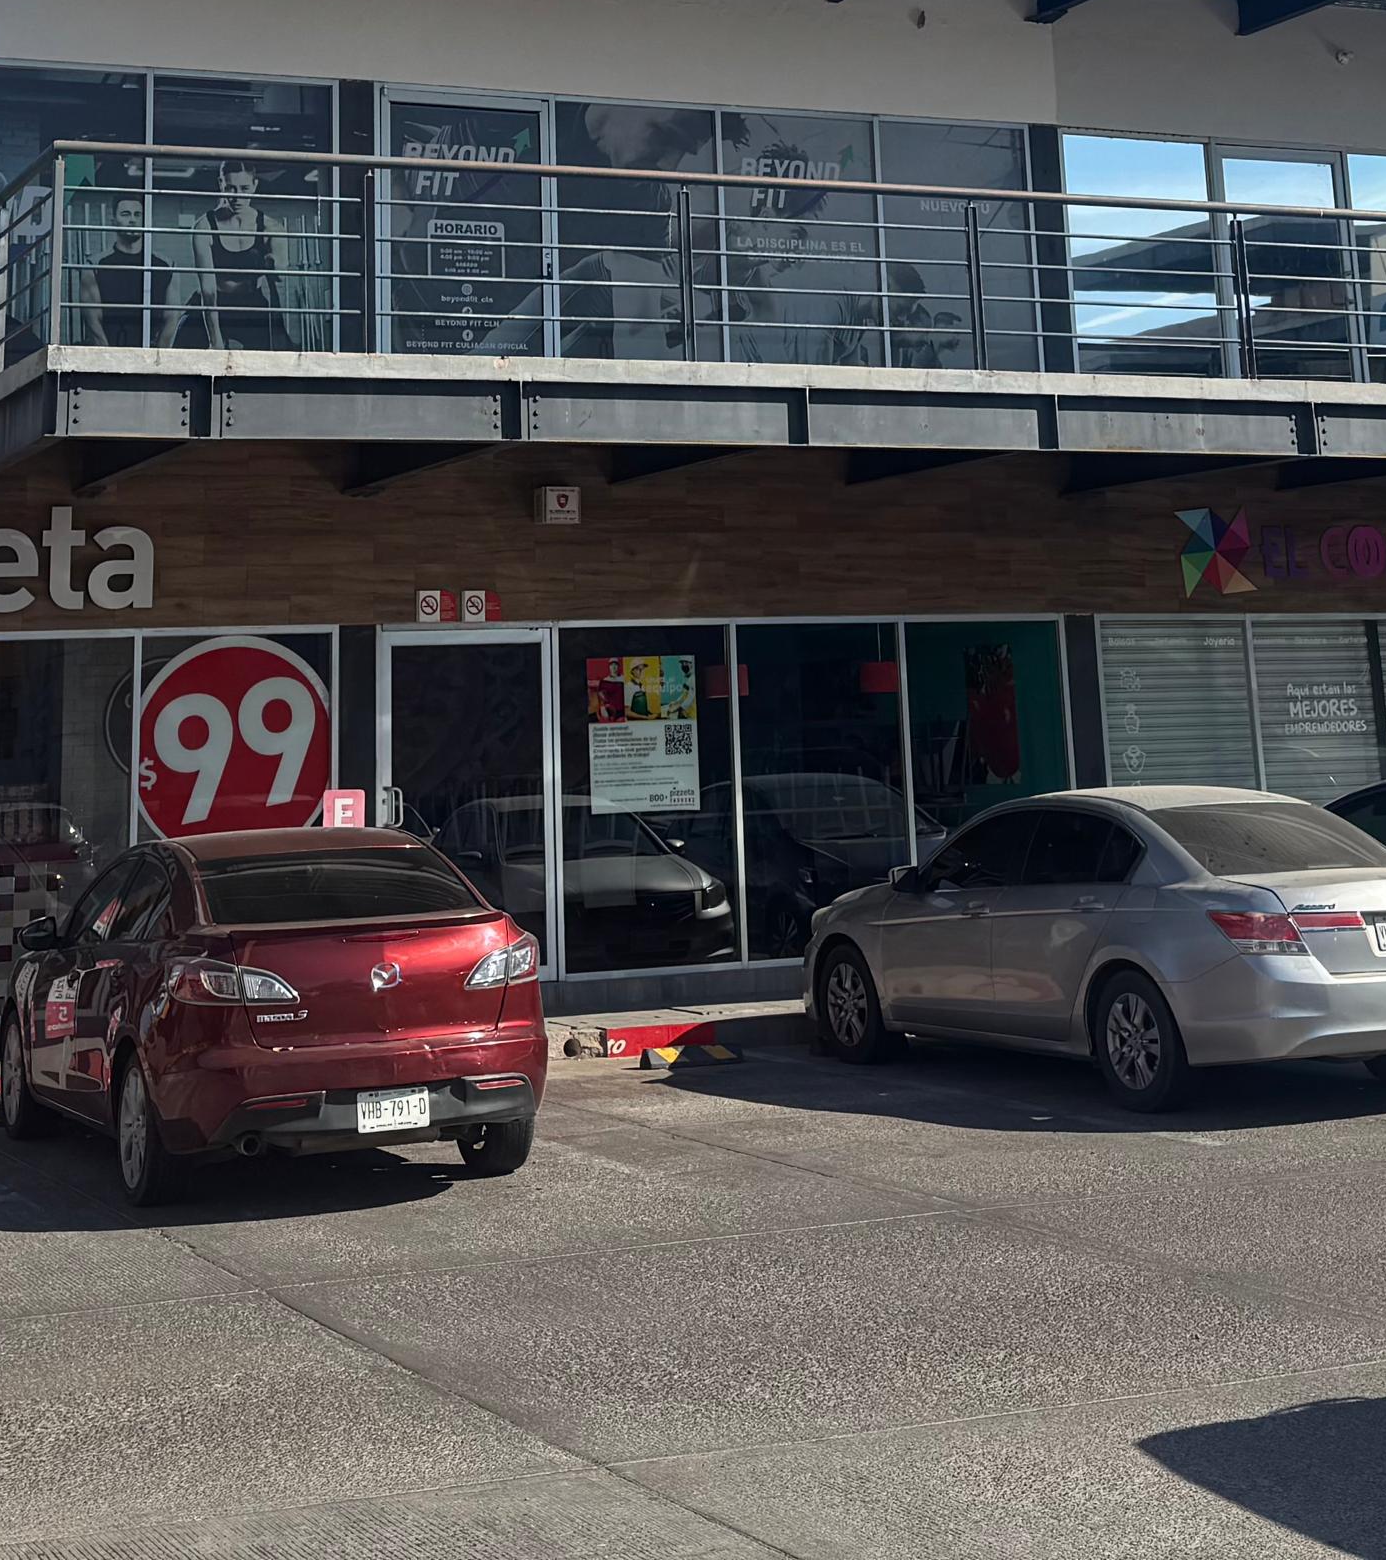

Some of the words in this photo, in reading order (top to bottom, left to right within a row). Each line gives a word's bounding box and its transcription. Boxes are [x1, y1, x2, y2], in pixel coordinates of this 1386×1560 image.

[415, 171, 460, 196] FIT
[434, 222, 498, 235] HORARIO
[757, 238, 827, 251] DISCIPLINA
[831, 241, 846, 251] ES
[850, 242, 866, 252] EL
[1261, 525, 1309, 578] EL
[1289, 698, 1358, 718] MEJORES
[1285, 720, 1367, 735] EMPRENDEDORES
[361, 1096, 426, 1120] VHB-791-D
